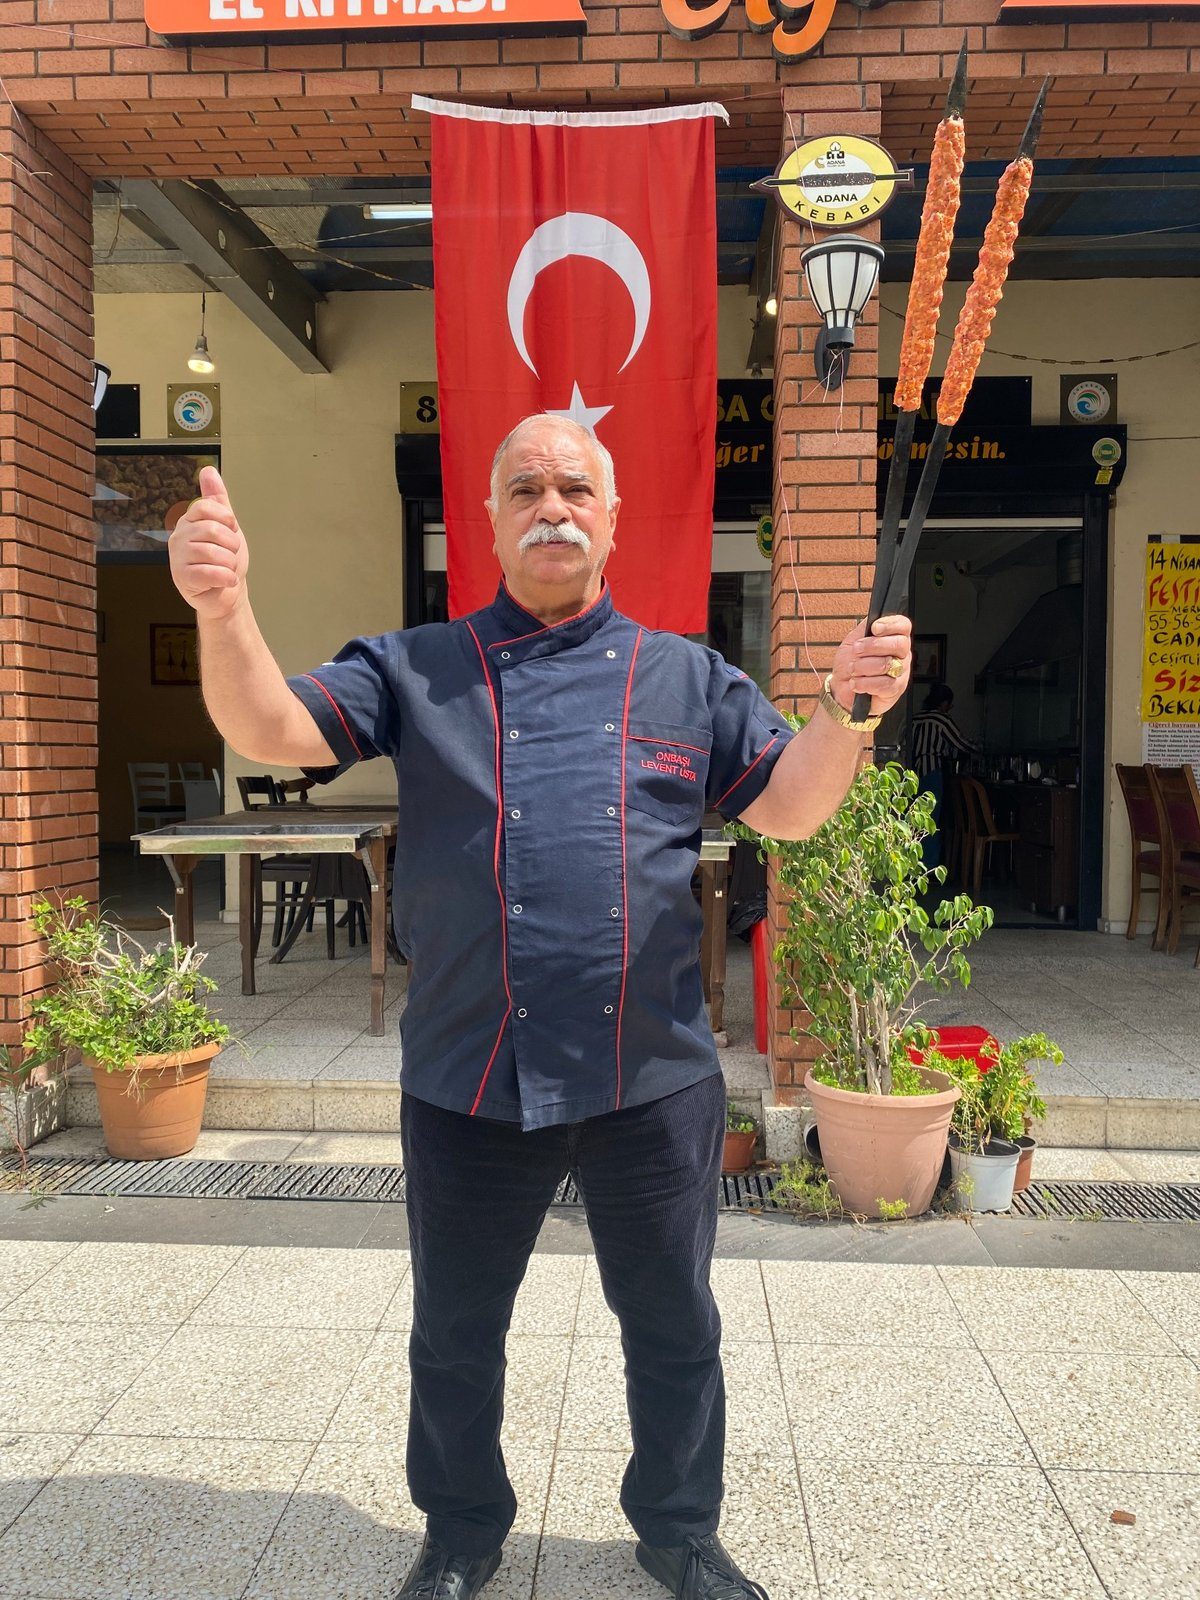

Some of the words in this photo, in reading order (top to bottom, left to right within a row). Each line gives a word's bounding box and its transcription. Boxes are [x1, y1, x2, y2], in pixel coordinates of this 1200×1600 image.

[794, 196, 881, 222] KEBABI
[816, 193, 858, 203] ADANA
[716, 441, 765, 468] ğer
[1149, 548, 1167, 571] 14
[641, 760, 678, 775] LEVENT
[680, 768, 697, 782] USTA
